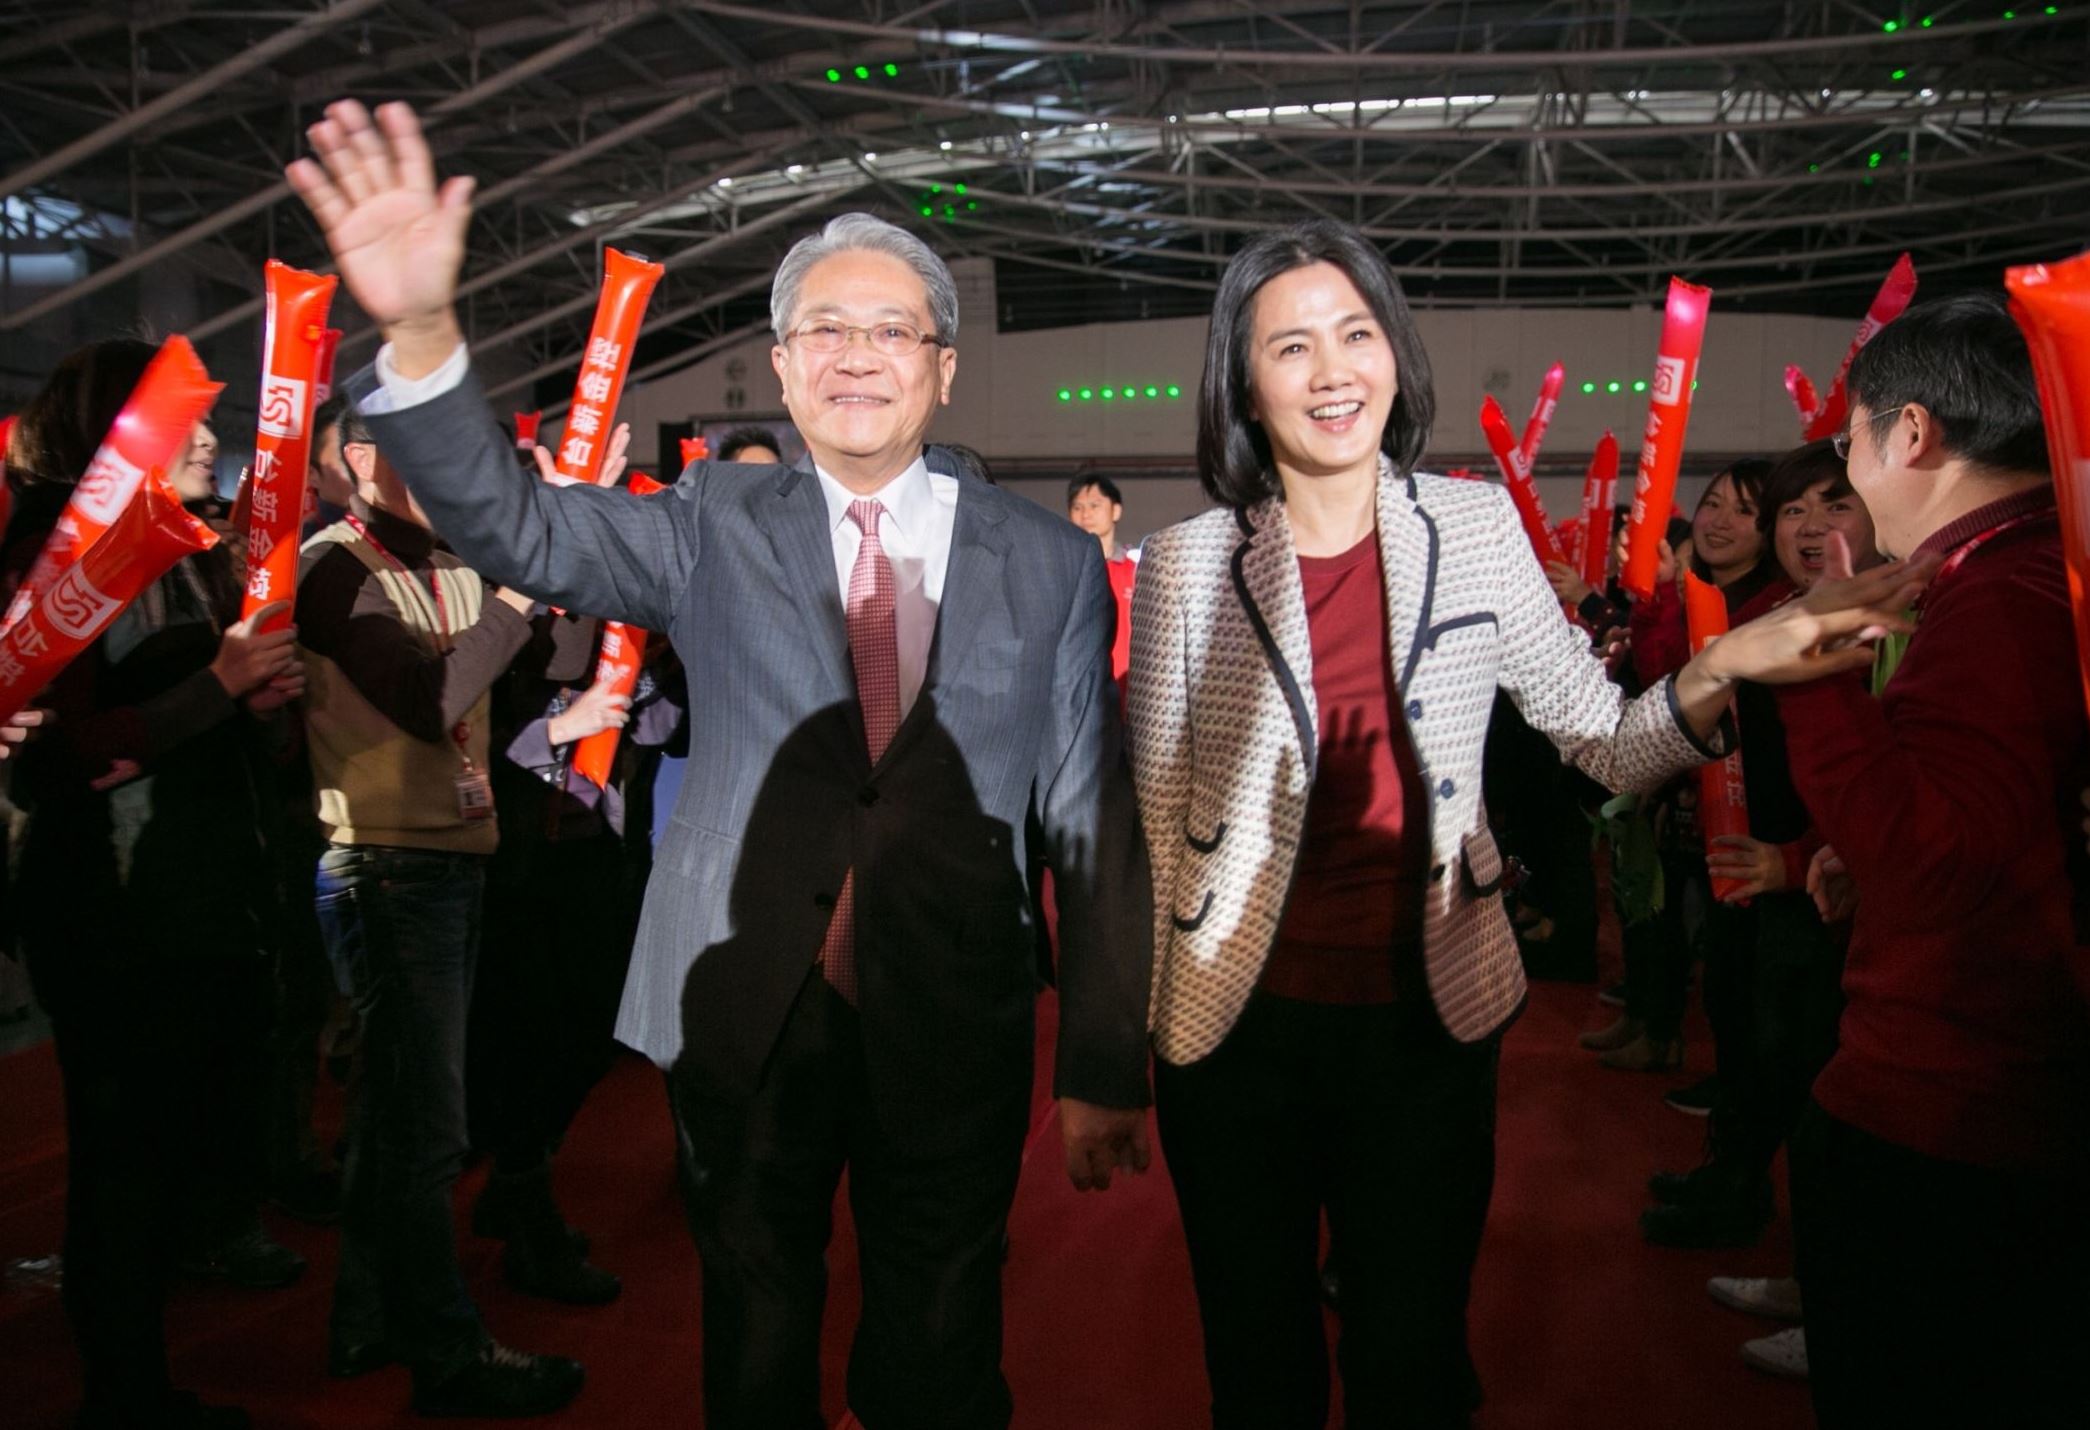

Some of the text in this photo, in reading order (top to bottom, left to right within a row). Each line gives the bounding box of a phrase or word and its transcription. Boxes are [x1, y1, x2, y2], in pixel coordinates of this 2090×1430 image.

[560, 336, 622, 467] 台新金控
[247, 447, 283, 601] 台新金控
